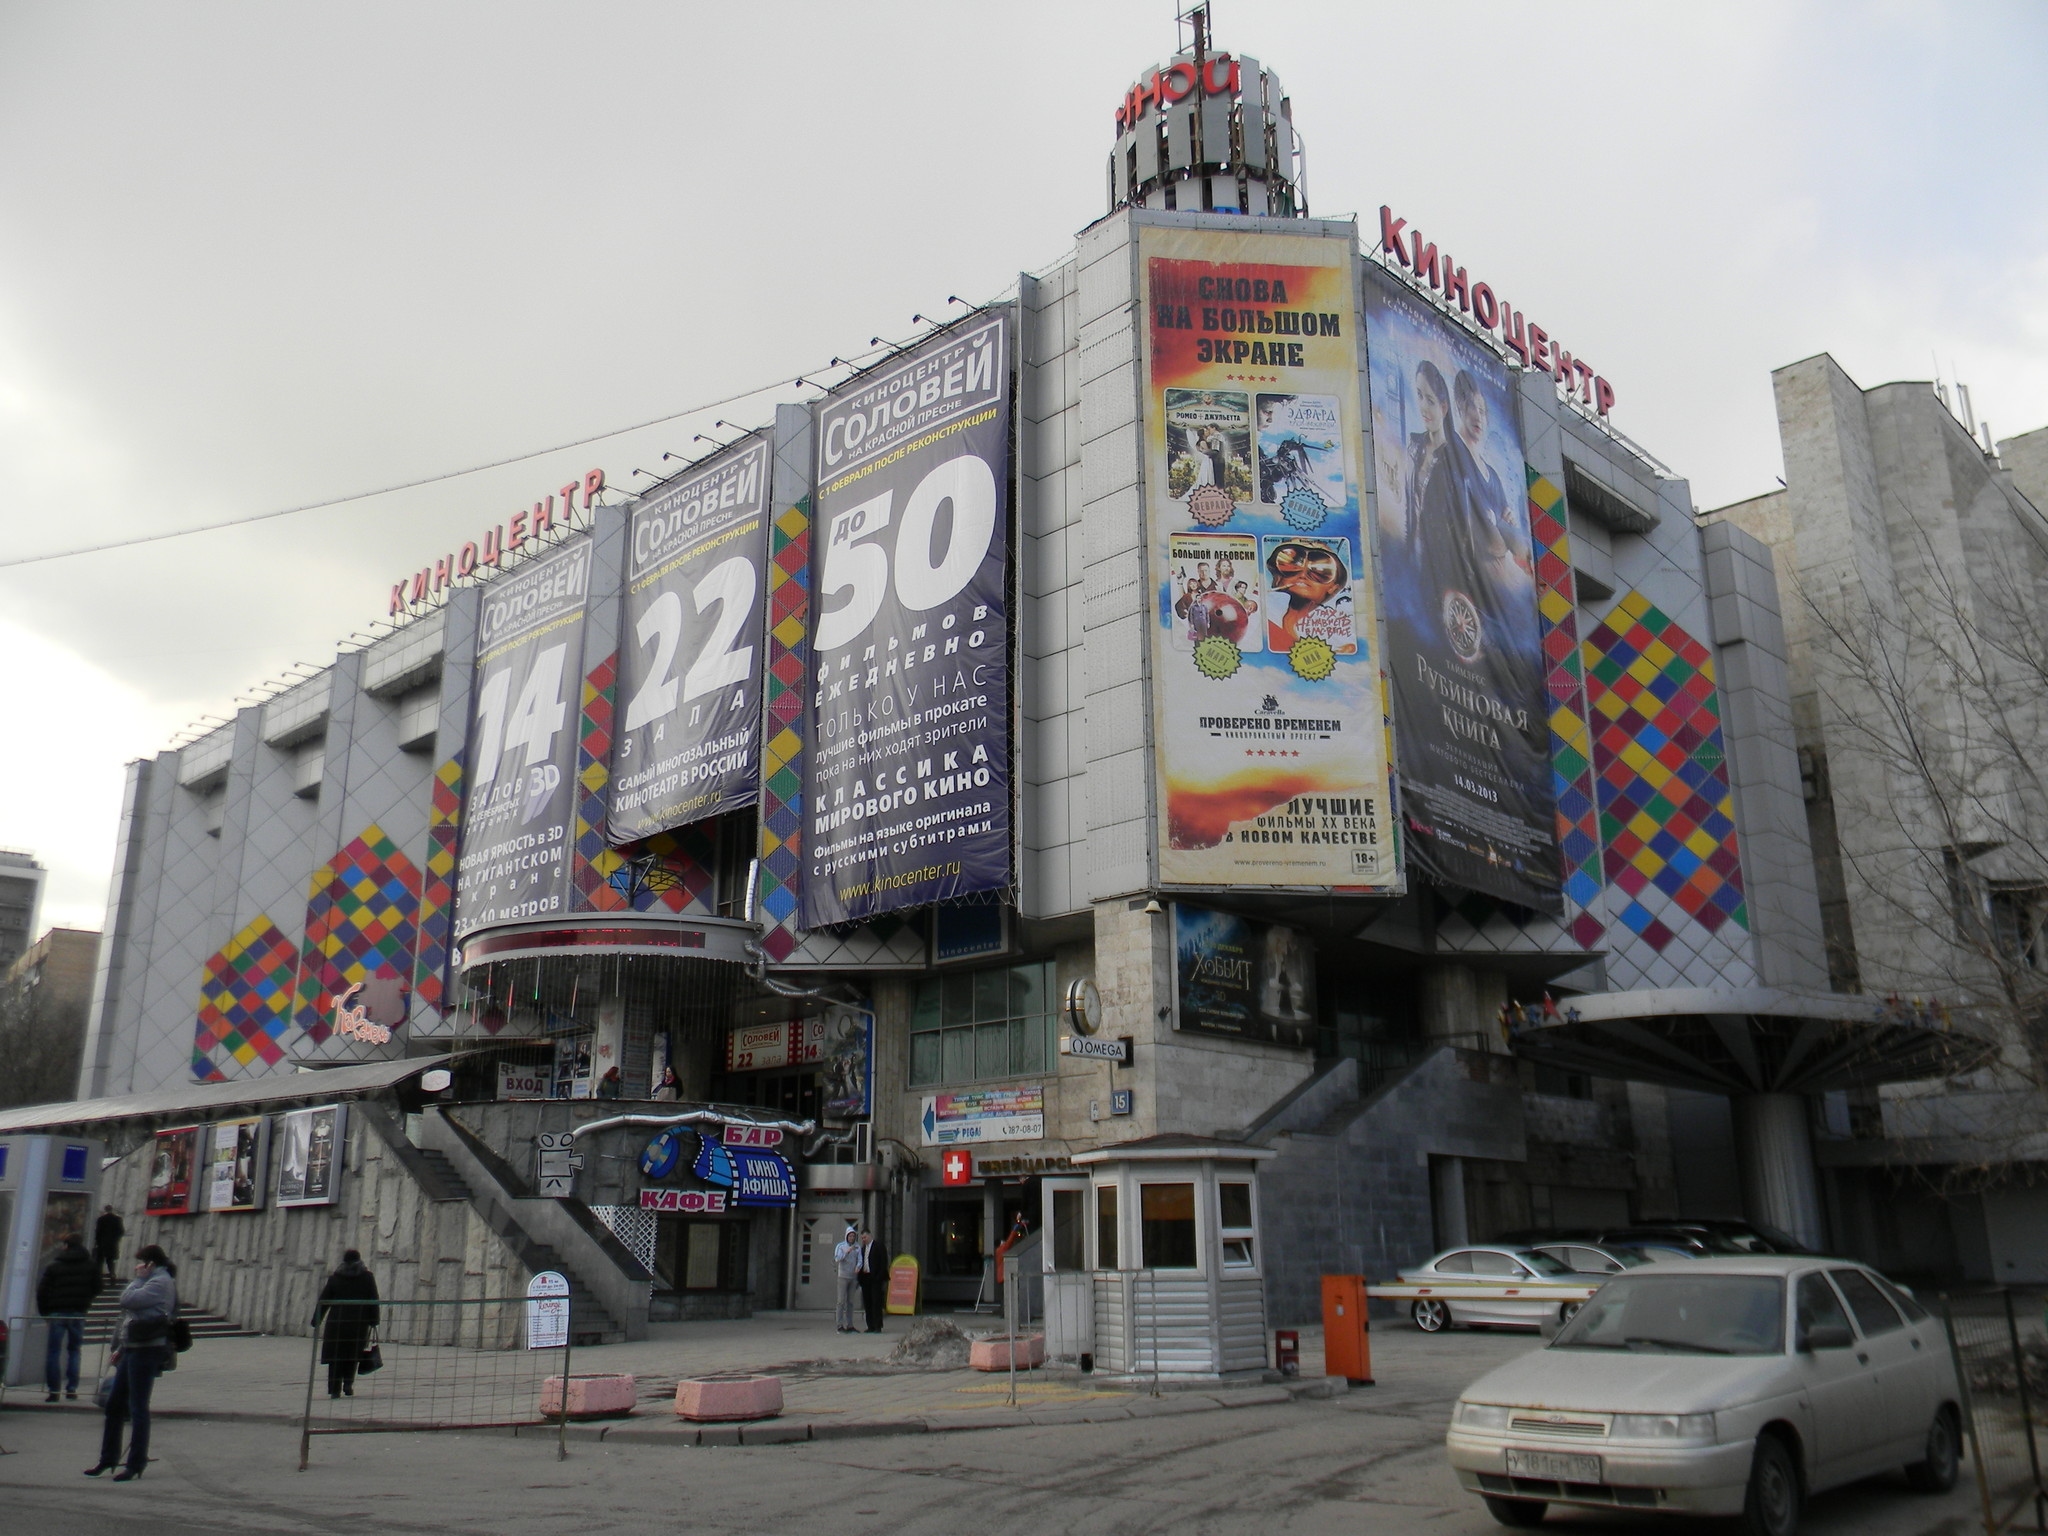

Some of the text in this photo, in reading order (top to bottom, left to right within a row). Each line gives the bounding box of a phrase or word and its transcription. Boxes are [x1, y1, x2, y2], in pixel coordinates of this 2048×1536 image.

[1197, 276, 1288, 305] СНОВА
[1379, 205, 1616, 417] КИНОЦЕНТР
[1156, 304, 1341, 338] НА БОЛЬШОМ
[1196, 338, 1305, 369] ЭКРАНЕ
[825, 331, 992, 466] СОЛОВЕЙ
[852, 346, 965, 410] КИНОЦЕНТР
[848, 399, 963, 461] НА КРАСНОЙ ПРЕСНЕ
[1176, 412, 1241, 422] РОМЕО ДЖУЛЬЕТТА
[818, 489, 825, 500] С
[831, 465, 873, 494] ФЕВРАЛЯ
[874, 446, 905, 471] ПОСЛЕ
[906, 407, 998, 456] РЕКОНСТРУКЦИИ
[635, 450, 759, 565] СОЛОВЕЙ
[654, 463, 739, 515] КИНОЦЕНТР
[1193, 499, 1231, 512] ФЕВРАЛЬ
[1287, 499, 1321, 520] ФЕВРАЛЬ
[389, 468, 605, 617] КИНОЦЕНТР
[652, 511, 734, 561] НА КРАСНОЙ ПРЕСНЕ
[833, 510, 867, 547] ДО
[640, 564, 670, 588] ФЕВРАЛЯ
[691, 519, 760, 561] РЕКОНСТРУКЦИИ
[813, 454, 997, 652] 50
[1172, 548, 1256, 561] БОЛЬШОЙ ЛЕБОВСКИ
[482, 547, 586, 643] СОЛОВЕЙ
[499, 558, 569, 599] КИНОЦЕНТР
[625, 556, 757, 733] 22
[1205, 646, 1230, 667] МАРТ
[814, 630, 986, 709] ЕЖЕДНЕВНО
[476, 642, 567, 788] 14
[620, 688, 745, 759] ЗАЛА
[815, 694, 894, 743] ТОЛЬКО
[933, 664, 988, 699] НАС
[1199, 716, 1342, 732] ПРОВЕРЕНО ВРЕМЕНЕМ
[1254, 708, 1286, 716] Caravella
[815, 694, 988, 765] лучшие фильмы в прокате
[1290, 732, 1317, 741] ПРОЕКТ
[1441, 703, 1502, 751] КНИГА
[617, 727, 750, 792] САМЫЙ МНОГОЗАЛЬНЫЙ
[815, 715, 988, 784] пока на них ходят зрители
[471, 777, 523, 812] ЗАЛОВ
[530, 764, 561, 797] 3D
[615, 749, 748, 813] КИНОТЕАТР В РОССИИ
[815, 744, 989, 814] КЛАССИКА
[1454, 773, 1499, 803] 14.03.2013
[637, 790, 723, 830] www.kinocenter.ru
[815, 767, 990, 835] МИРОВОГО КИНО
[1286, 798, 1375, 817] ЛУЧШИЕ
[813, 801, 991, 860] Фильмы на языке оригинала
[1225, 831, 1377, 845] В НОВОМ КАЧЕСТВЕ
[1257, 816, 1377, 830] ФИЛЬМЫ XX ВЕКА
[458, 825, 564, 873] НОВАЯ ЯРКОСТЬ в 3D
[813, 819, 992, 876] с русскими субтитрами
[1234, 858, 1327, 868] www.provereno-vremenem.ru
[1355, 852, 1376, 864] 18+
[455, 866, 561, 909] экране
[457, 846, 562, 893] НА ГИГАНТСКОМ
[838, 860, 962, 901] www.kinocenter.ru
[453, 917, 468, 937] 23
[481, 909, 495, 924] 10
[499, 895, 560, 921] метров
[742, 1028, 780, 1047] СОЛОВЕЙ
[804, 1044, 818, 1060] 14
[1084, 1037, 1123, 1056] OMEGA
[737, 1053, 753, 1069] 22
[506, 1077, 543, 1094] ВХОД
[1114, 1095, 1126, 1109] 15
[725, 1126, 782, 1146] БАР
[742, 1178, 790, 1197] АФИША
[746, 1159, 780, 1179] КИНО
[641, 1190, 726, 1211] КАФЕ
